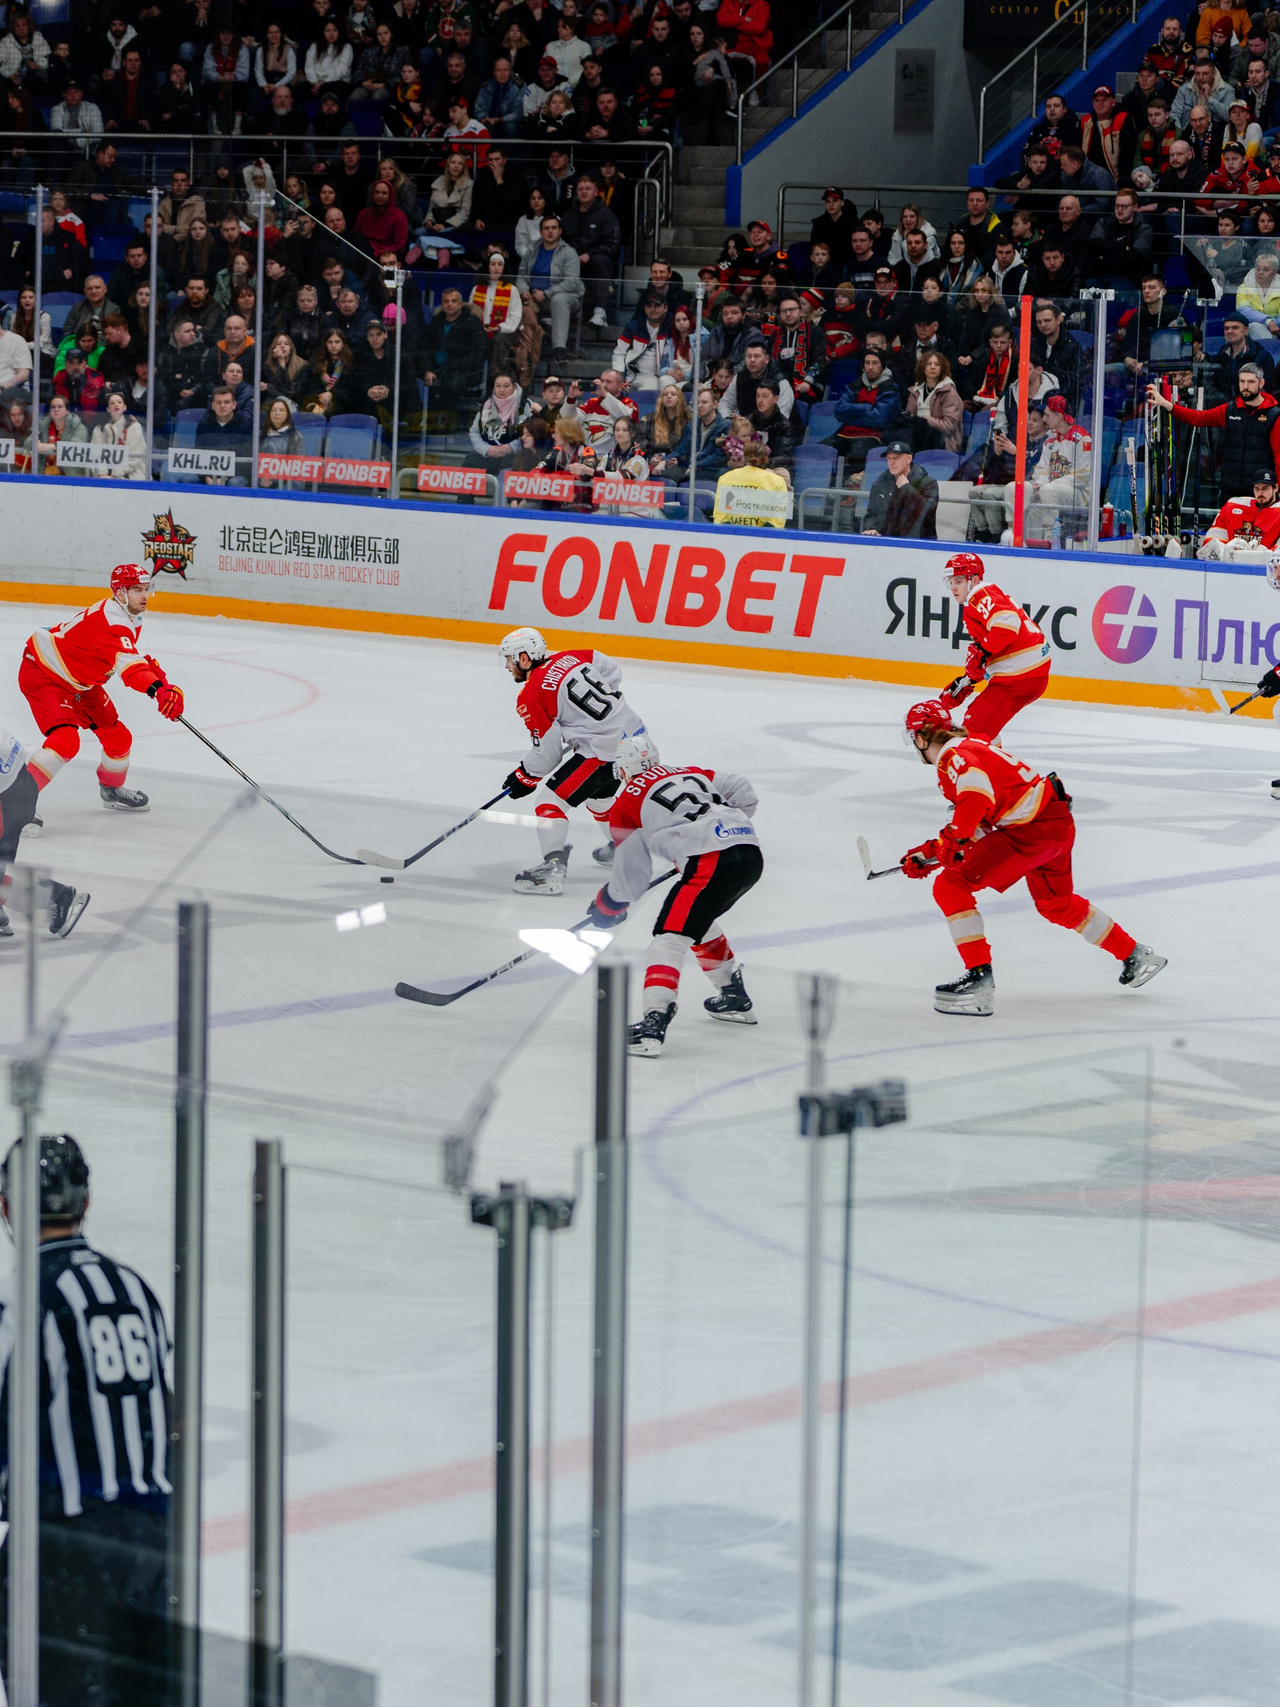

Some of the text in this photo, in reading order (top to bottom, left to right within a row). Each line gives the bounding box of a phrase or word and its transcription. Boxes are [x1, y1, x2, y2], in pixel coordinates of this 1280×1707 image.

[60, 446, 125, 466] KHL.RU
[172, 452, 232, 472] KHL.RU
[258, 457, 322, 478] FONBET
[324, 461, 389, 485] FONBET
[419, 469, 484, 491] FONBET
[505, 475, 573, 497] FONBET
[593, 481, 663, 504] FONBET
[736, 499, 787, 513] Ростелеком
[730, 516, 760, 526] SAFETY
[144, 540, 197, 563] REDSTAR
[220, 525, 400, 565] 北京昆仑鸿星冰球俱乐部
[219, 555, 400, 586] BEIJING KUNLUN RED STAR HOCKEY CLUB
[488, 532, 846, 637] FONBET
[976, 596, 996, 620] 32
[541, 654, 581, 691] CHISTYAKOV
[640, 759, 652, 771] 51
[947, 753, 967, 785] 94
[650, 775, 729, 822] 51
[88, 1313, 152, 1384] 86
